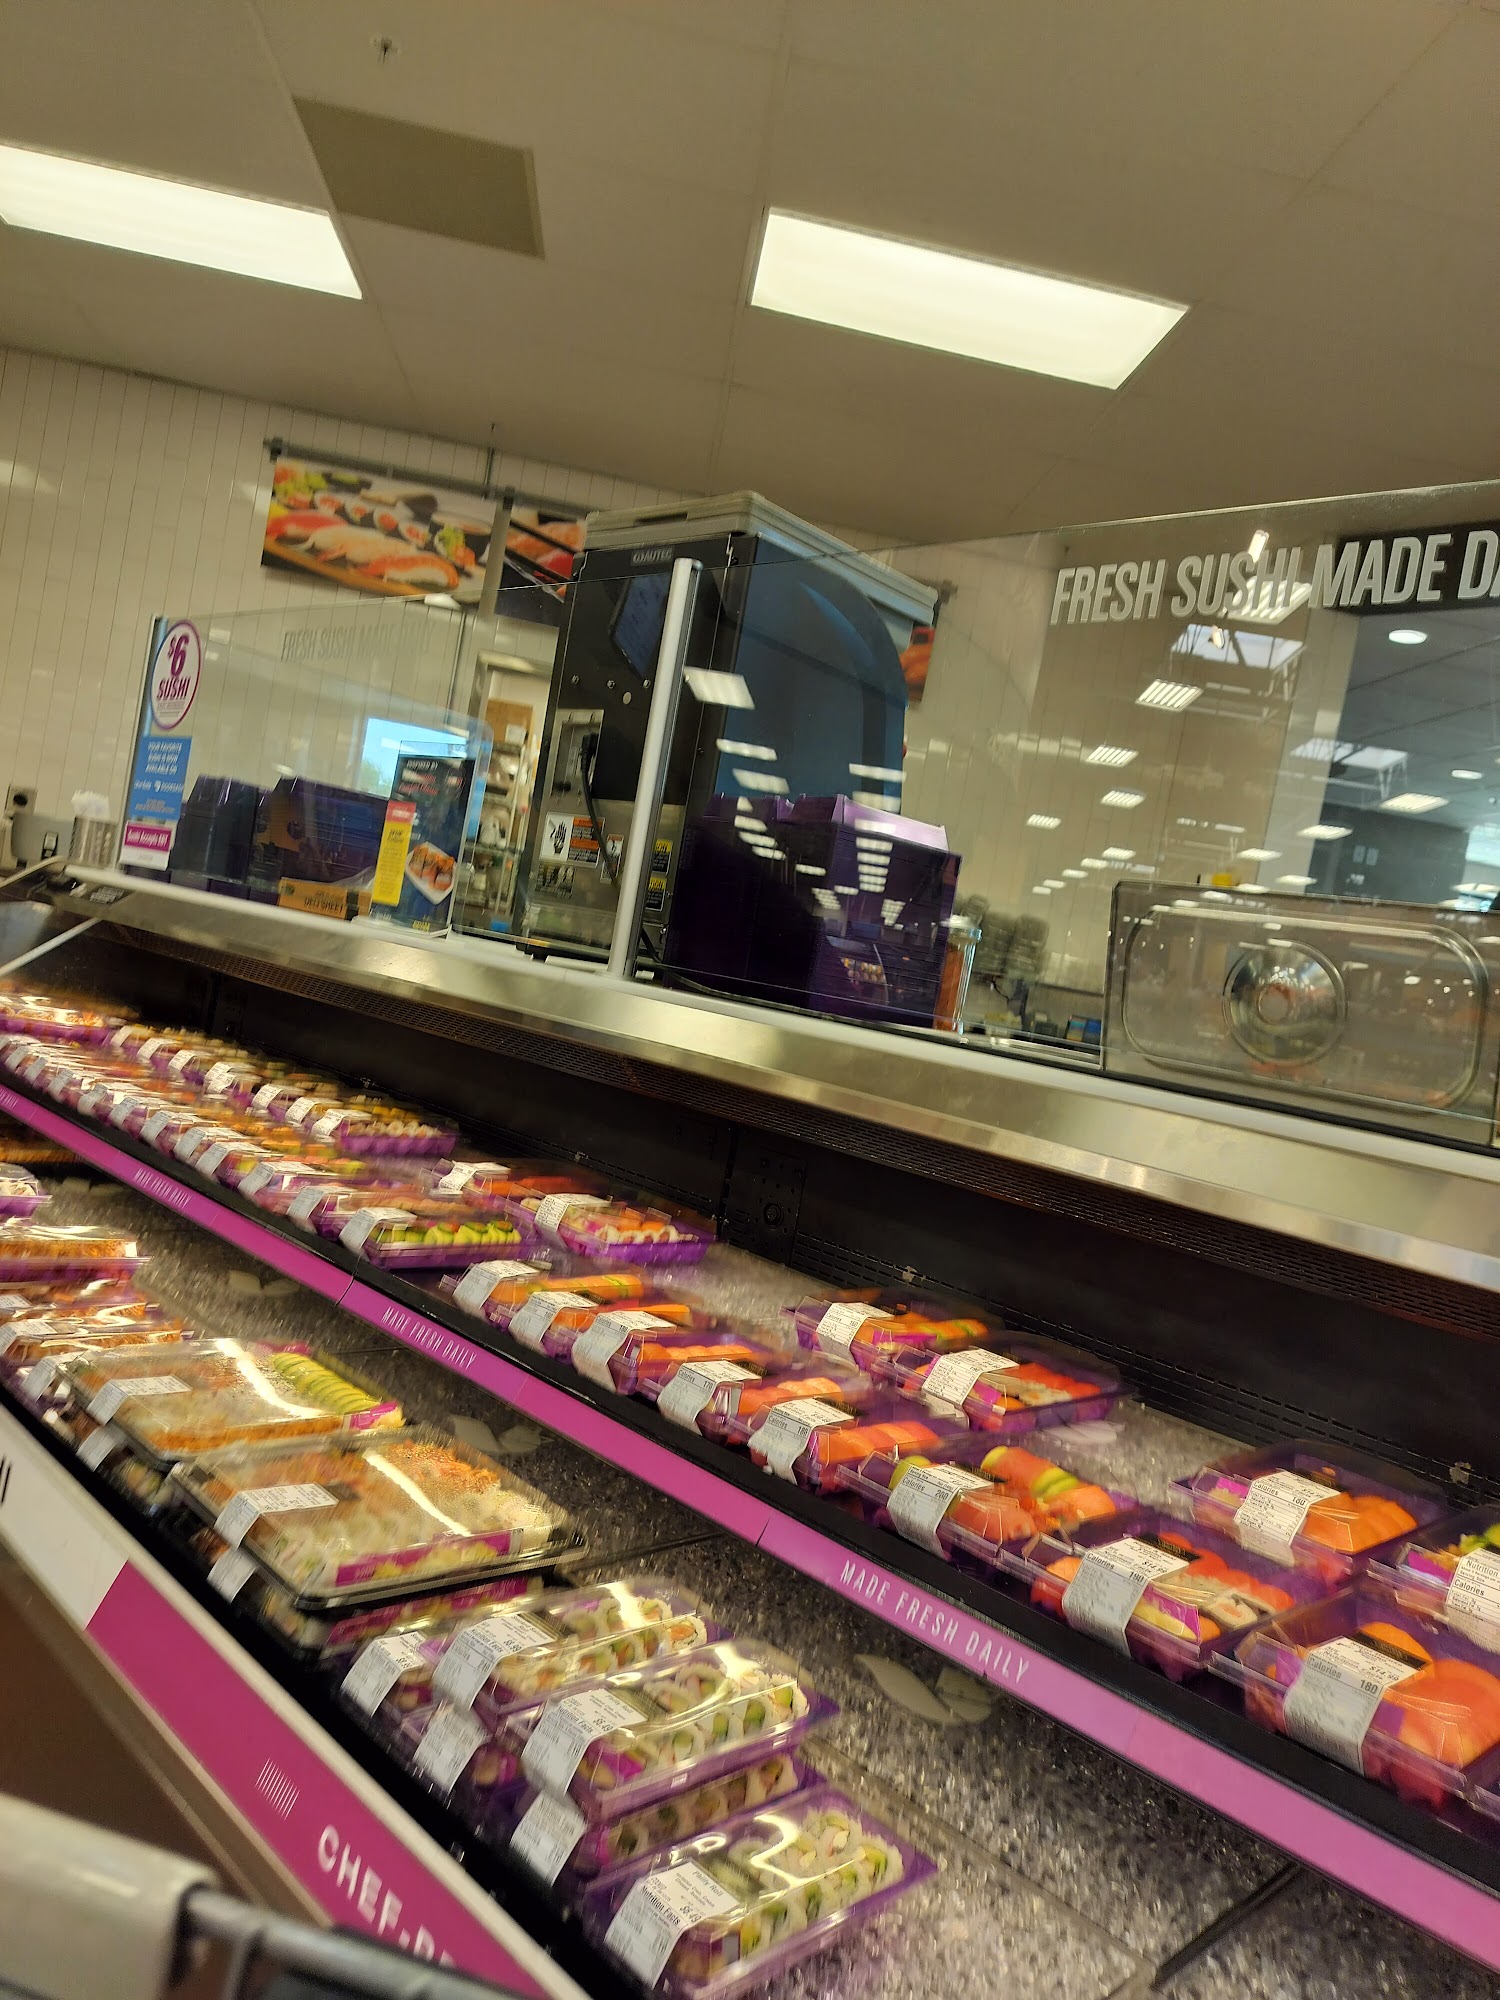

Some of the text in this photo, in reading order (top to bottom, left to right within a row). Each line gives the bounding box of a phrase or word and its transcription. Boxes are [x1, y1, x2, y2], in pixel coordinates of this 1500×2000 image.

[1050, 529, 1500, 626] FRESH SUSHI MADE D
[168, 634, 190, 677] $6
[157, 676, 191, 701] SUSHI
[381, 1305, 478, 1371] MADE FRESH DAILY
[1086, 1552, 1115, 1570] Calories
[1466, 1560, 1499, 1577] Nutrition
[1454, 1579, 1485, 1596] Calories
[840, 1559, 1030, 1684] MADE FRESH DAILY
[1307, 1657, 1342, 1680] Calories
[1369, 1665, 1399, 1682] $14.99
[664, 1906, 681, 1926] Facts
